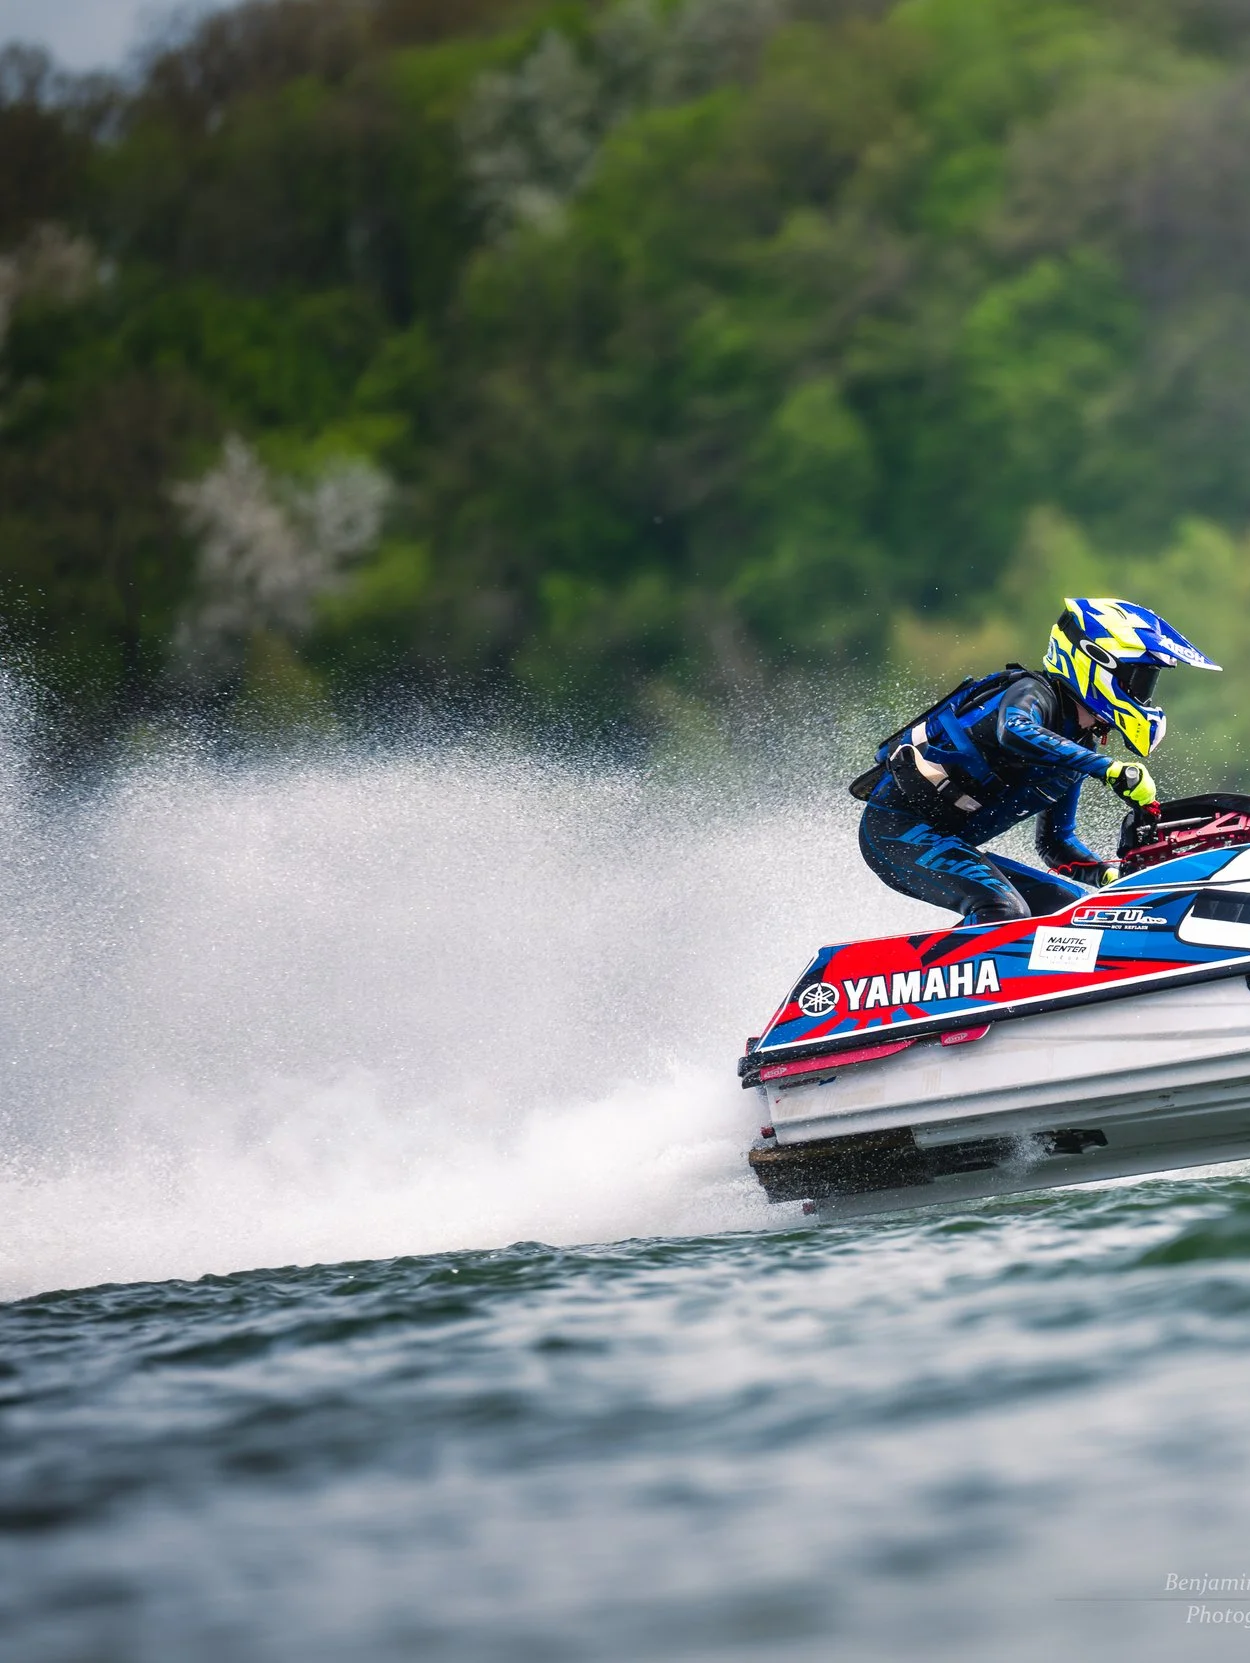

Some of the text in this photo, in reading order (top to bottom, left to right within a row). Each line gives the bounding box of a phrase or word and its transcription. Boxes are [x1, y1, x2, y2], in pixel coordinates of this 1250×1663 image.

[1047, 936, 1087, 945] NAUTIC
[1045, 944, 1087, 953] CENTER
[842, 958, 1001, 1011] YAMAHA
